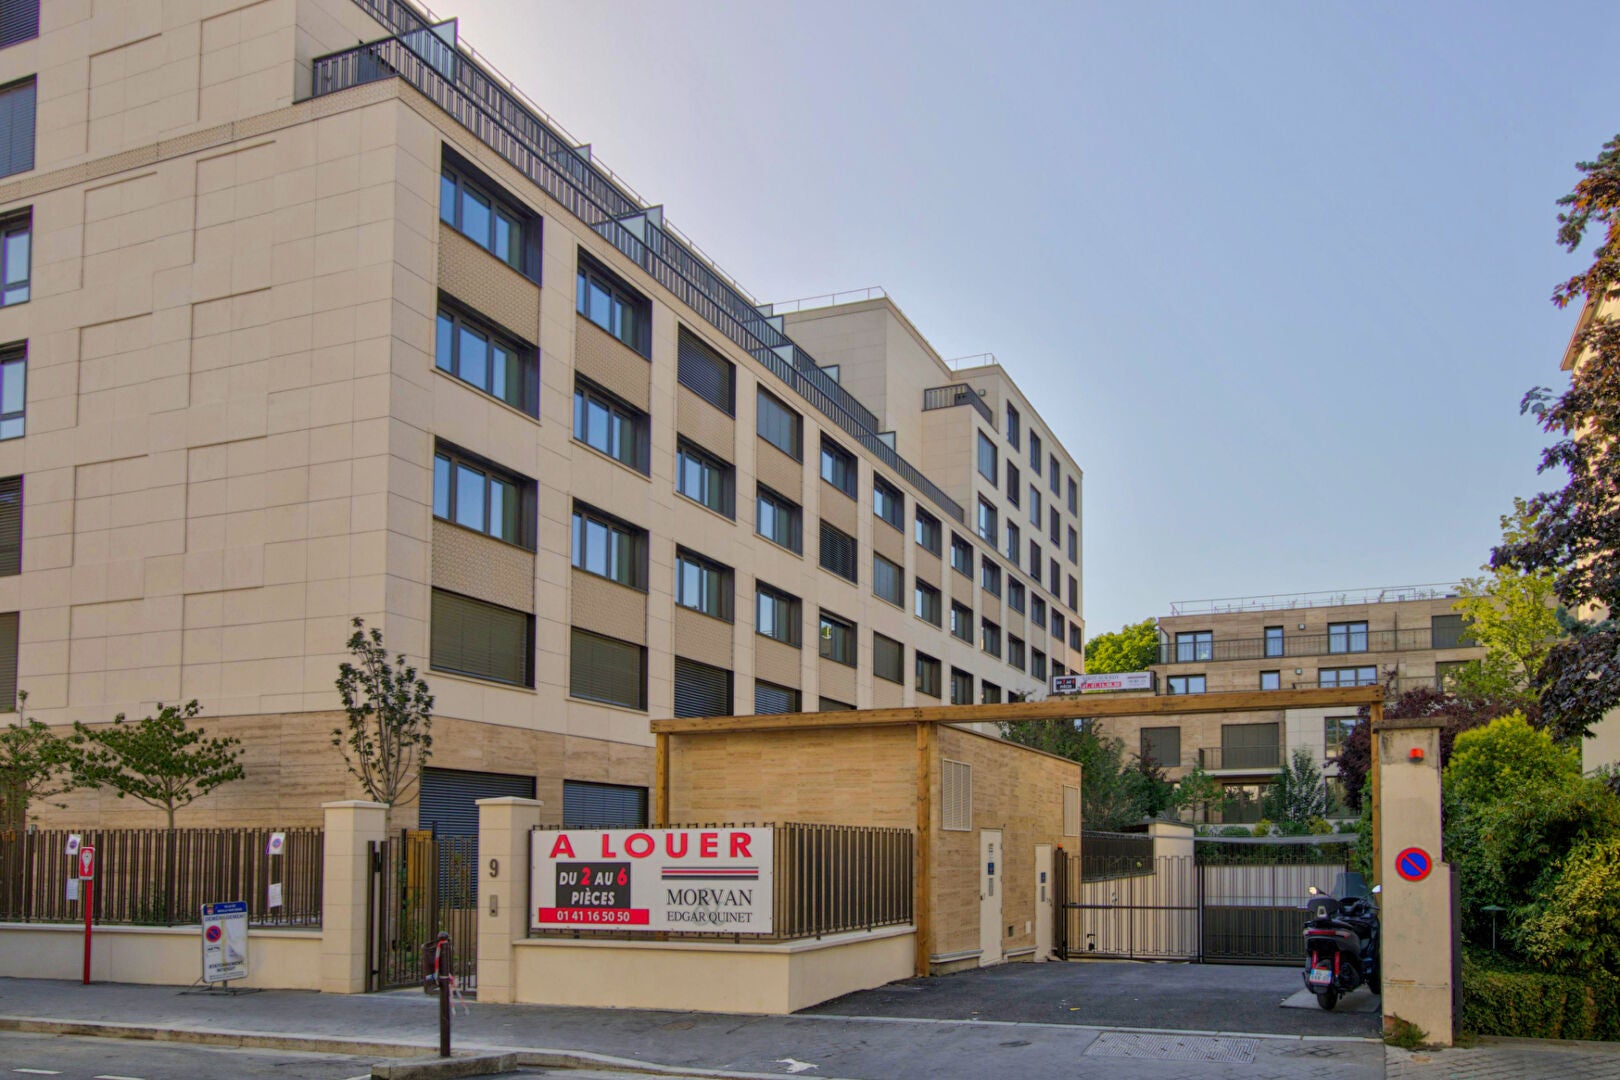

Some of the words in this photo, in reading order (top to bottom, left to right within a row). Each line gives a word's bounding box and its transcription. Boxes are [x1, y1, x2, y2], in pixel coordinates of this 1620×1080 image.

[549, 834, 576, 859] A
[601, 832, 753, 859] LOUER
[488, 858, 499, 878] 9
[558, 871, 578, 886] DU
[580, 866, 592, 886] 2
[594, 871, 614, 886] AU
[616, 867, 628, 886] 6
[571, 887, 616, 906] PIÈCES
[666, 888, 753, 906] MORVAN
[556, 910, 569, 921] 01
[571, 910, 584, 921] 41
[587, 911, 600, 921] 16
[602, 911, 615, 922] 50
[617, 911, 631, 922] 50
[666, 911, 706, 922] EDGAR
[708, 911, 753, 925] QUINET
